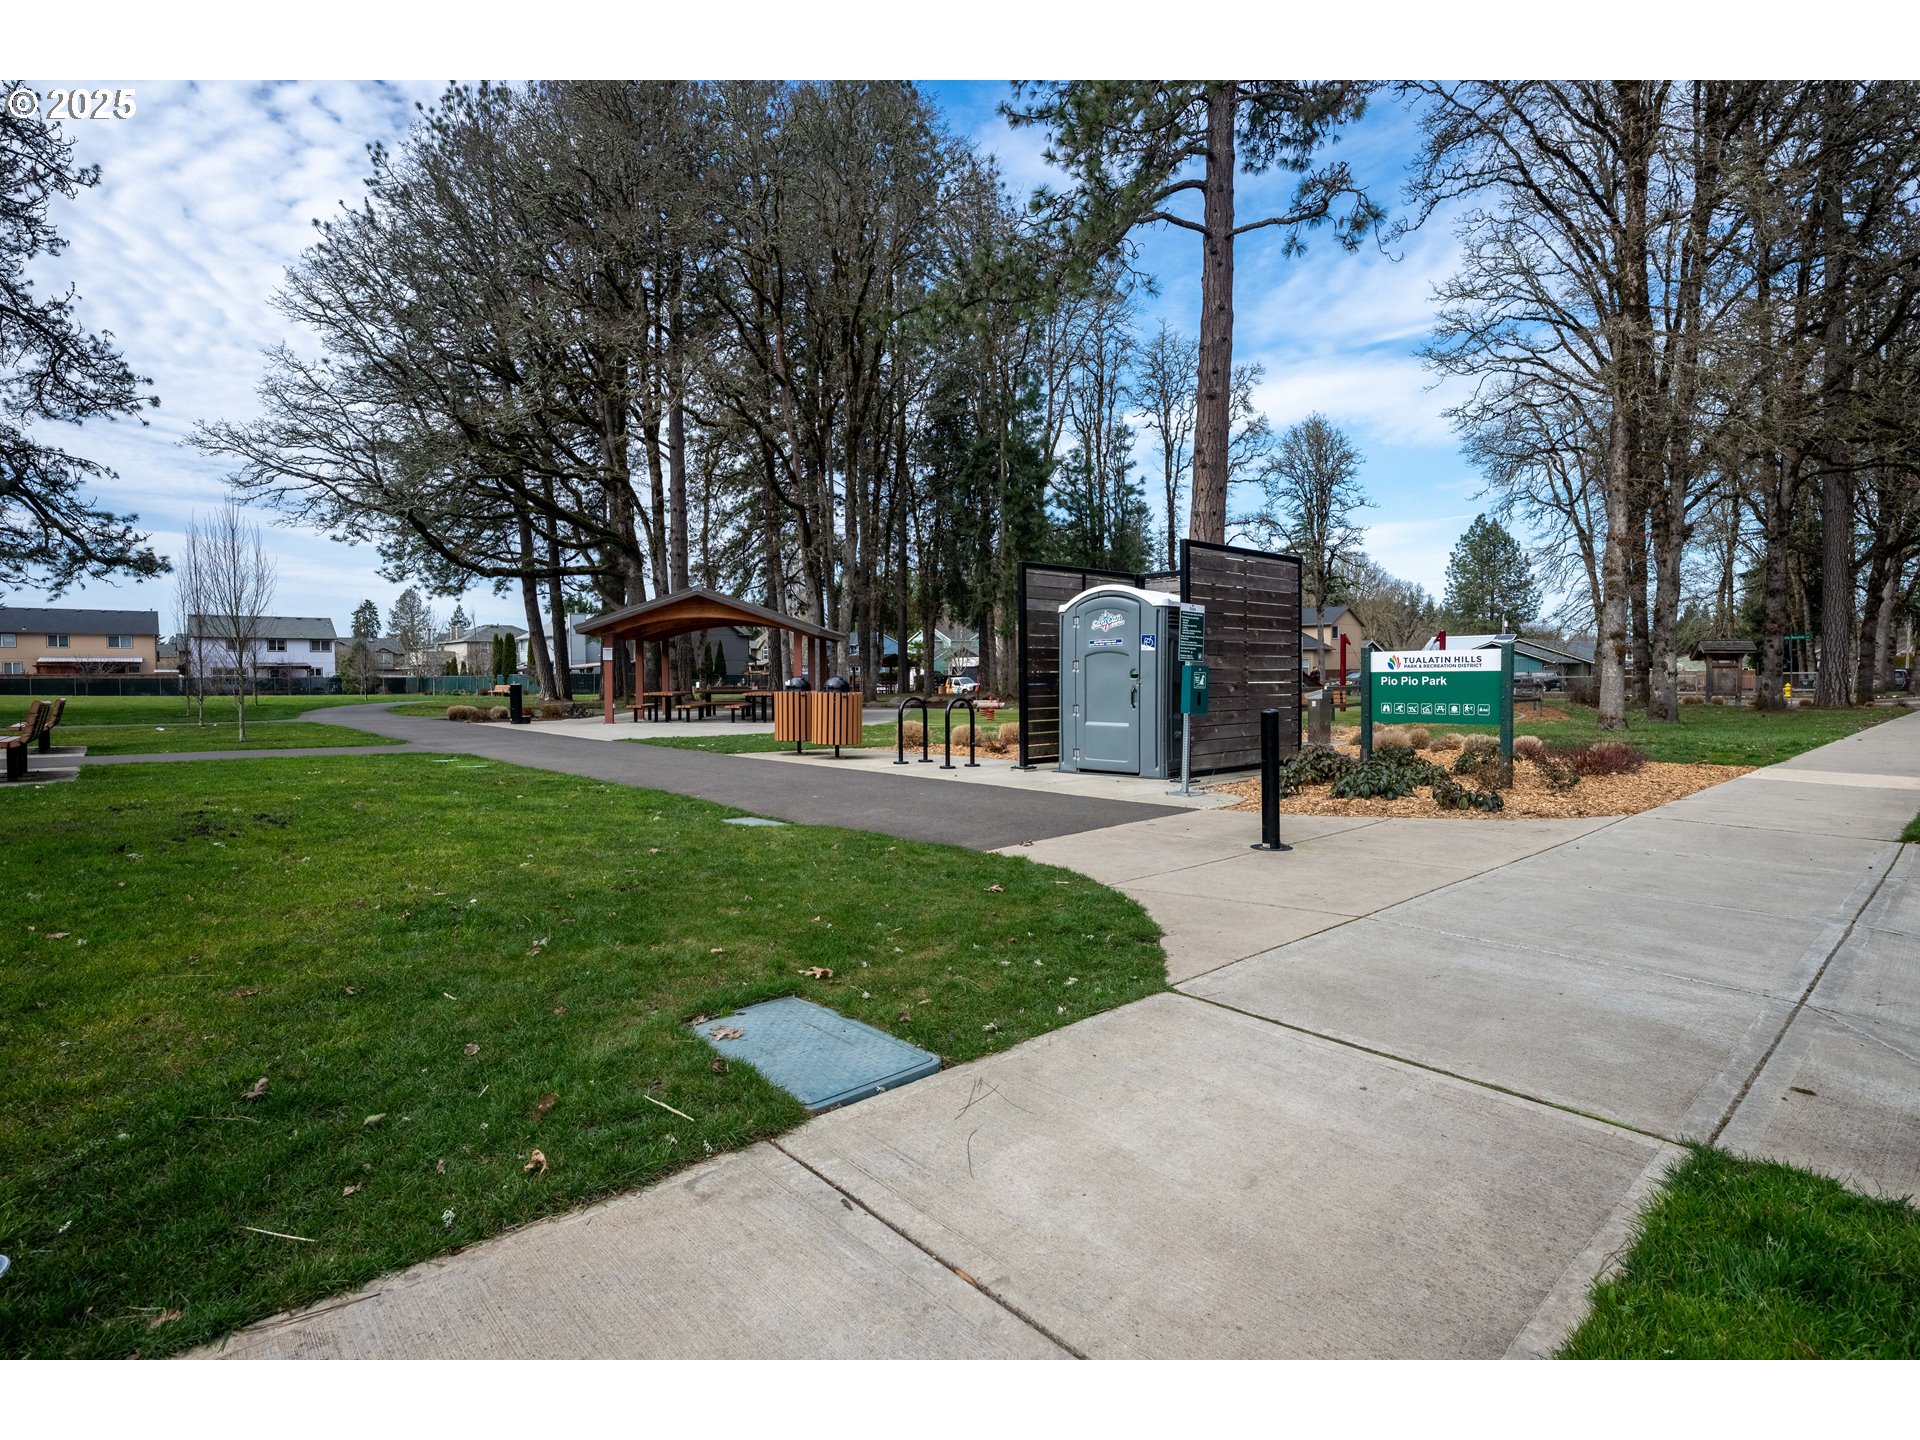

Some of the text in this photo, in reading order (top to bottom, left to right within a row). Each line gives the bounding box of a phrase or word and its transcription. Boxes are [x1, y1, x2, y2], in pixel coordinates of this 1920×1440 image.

[1380, 675, 1447, 686] Pio Pio Park
